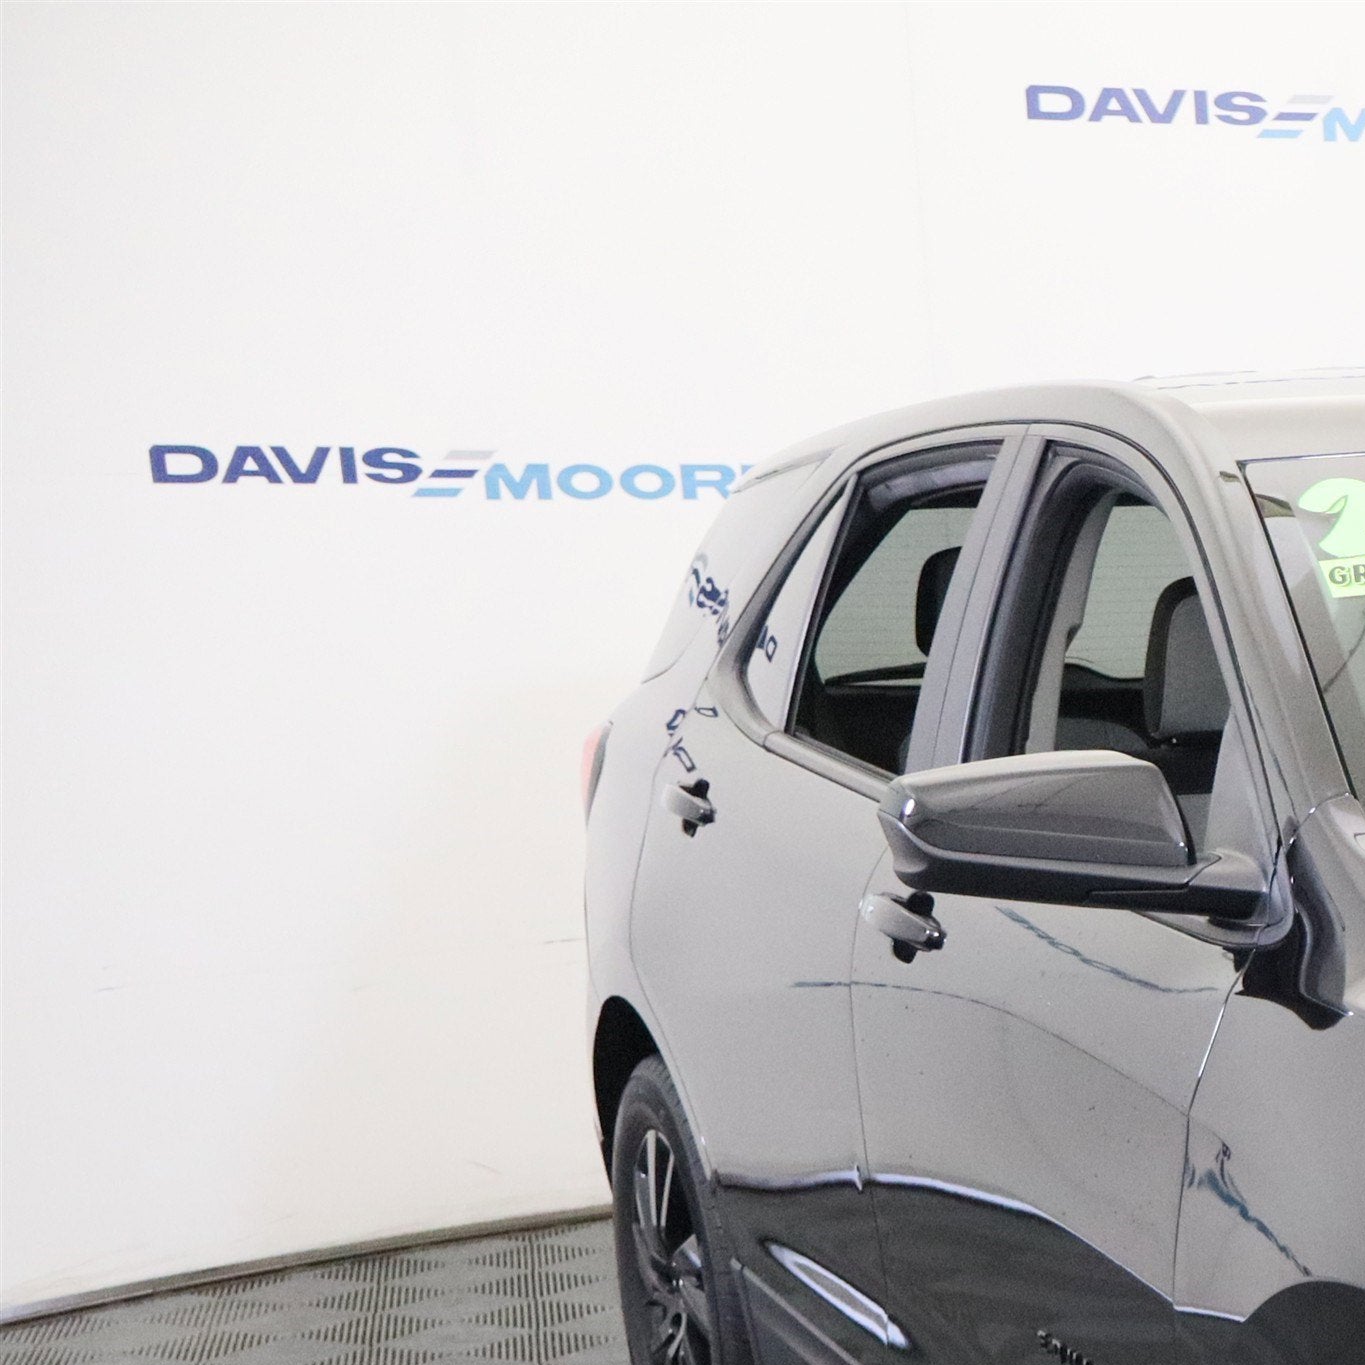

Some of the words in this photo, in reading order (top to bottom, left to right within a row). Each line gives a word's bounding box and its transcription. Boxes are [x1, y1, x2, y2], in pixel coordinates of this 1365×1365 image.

[1025, 85, 1268, 126] DAVIS
[149, 444, 423, 485] DAVIS
[484, 462, 757, 500] MOOR
